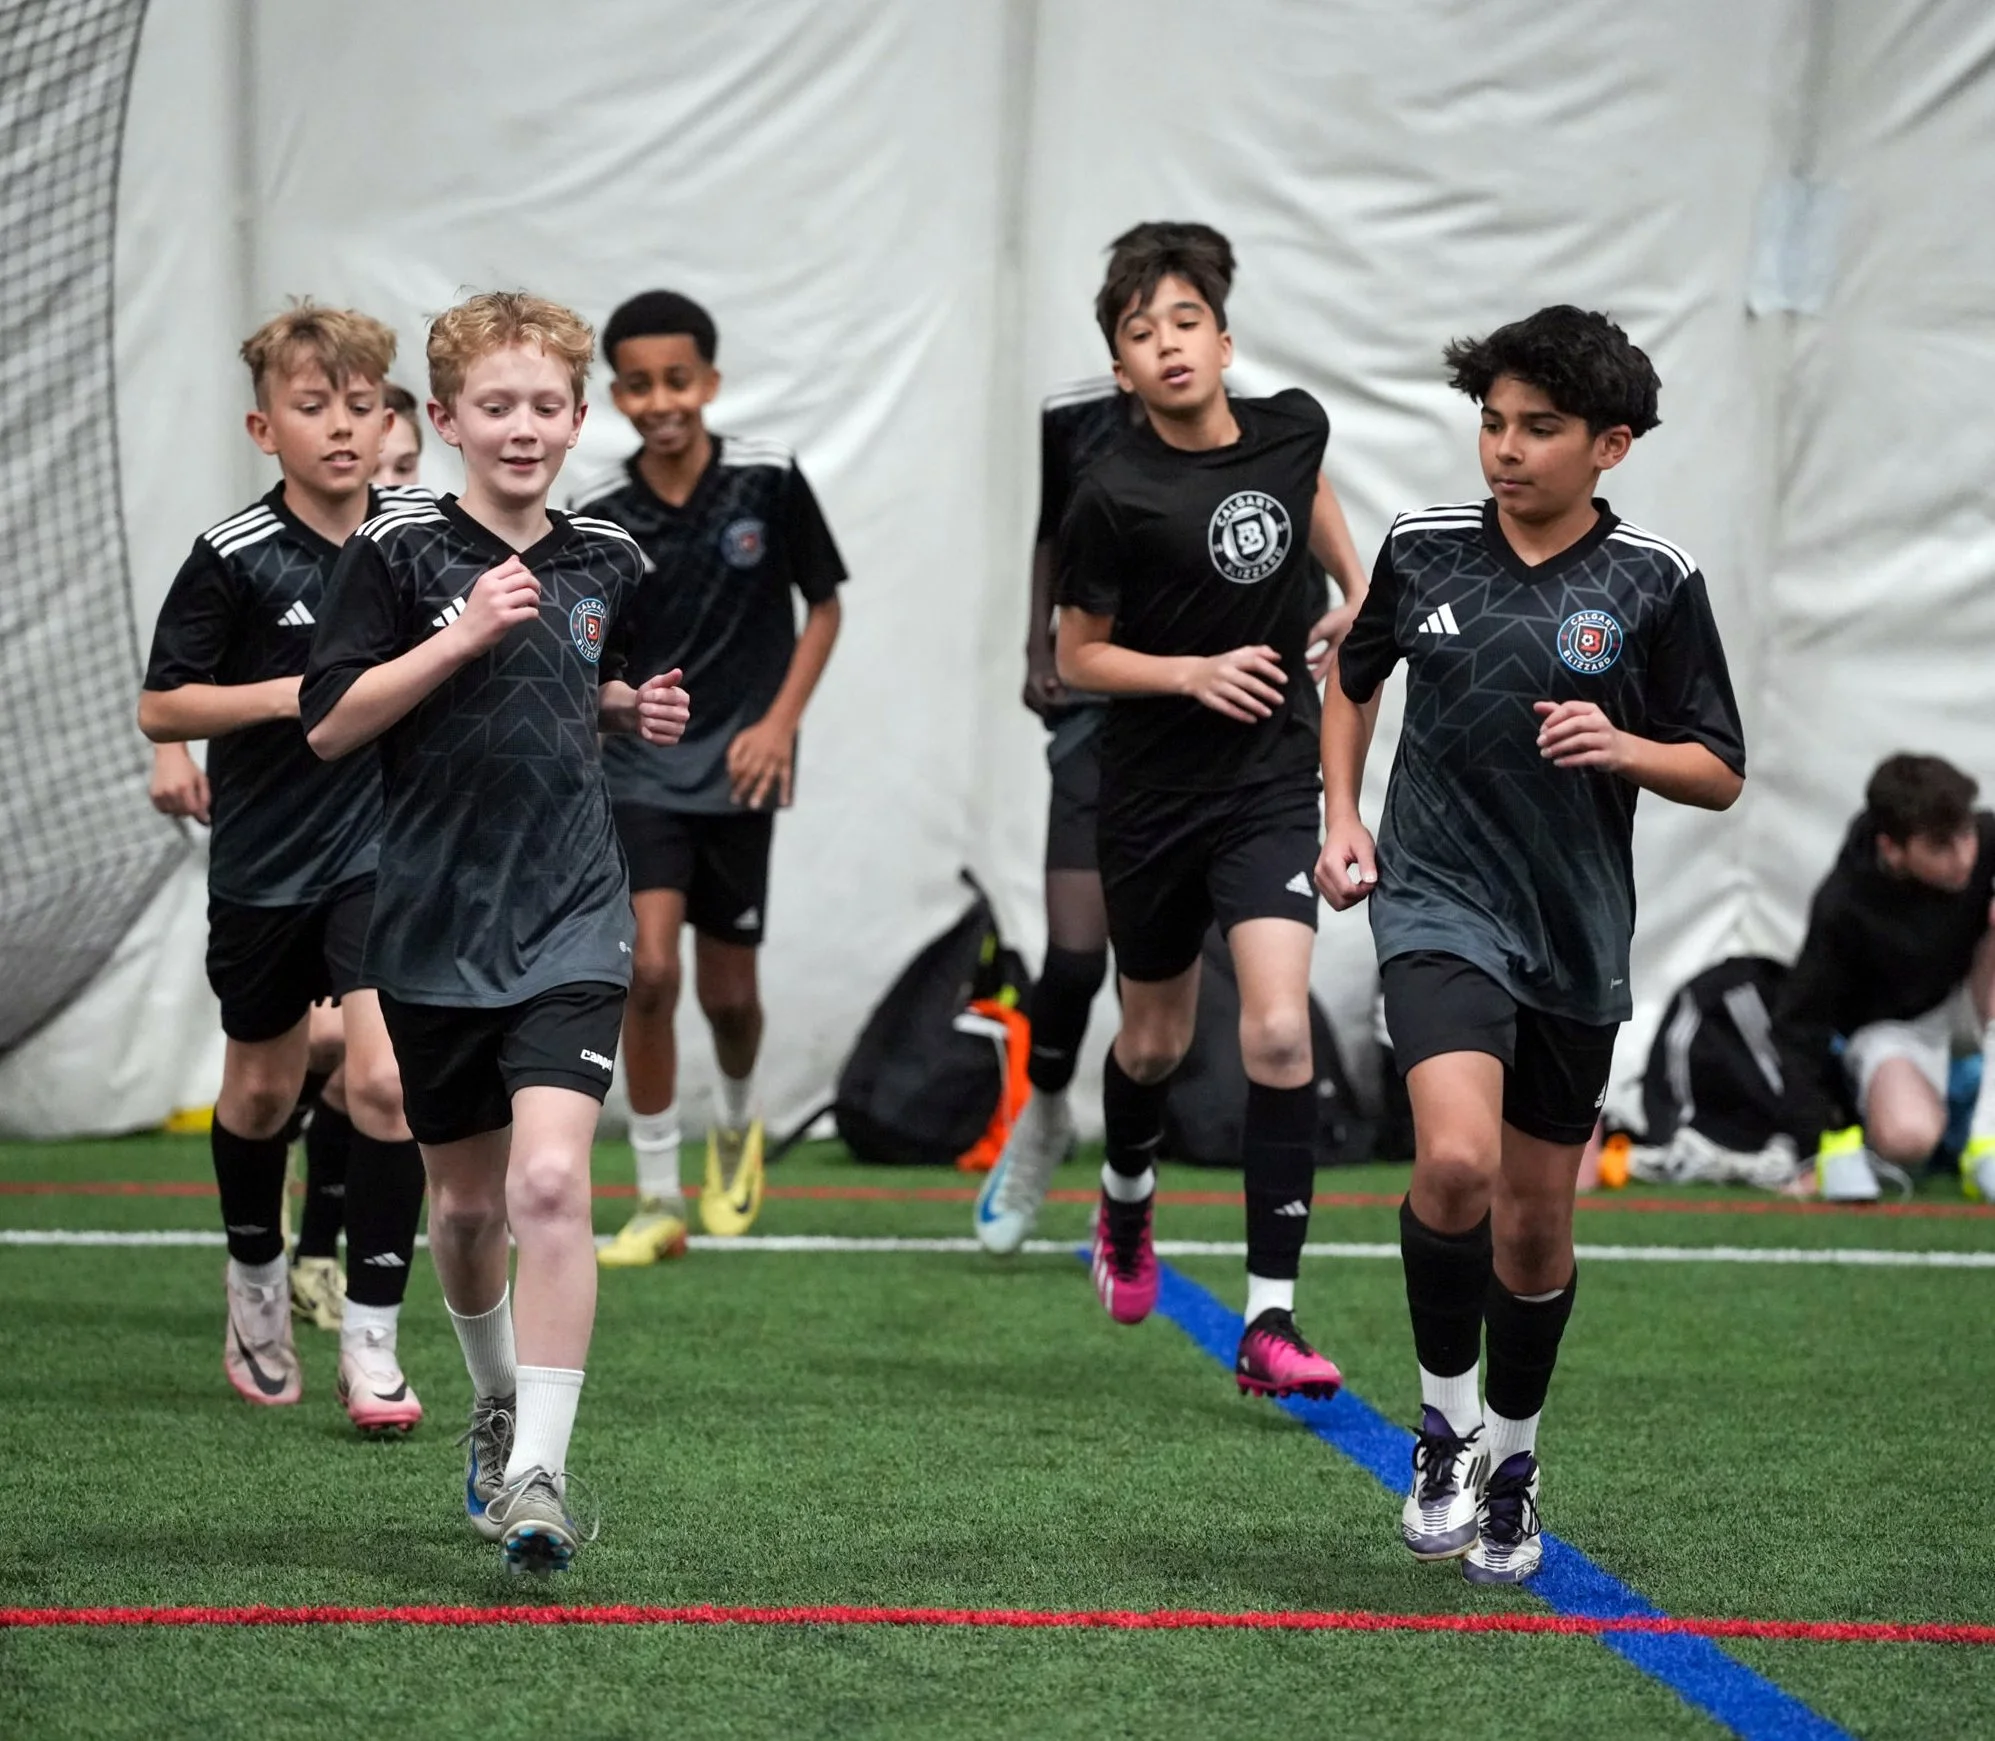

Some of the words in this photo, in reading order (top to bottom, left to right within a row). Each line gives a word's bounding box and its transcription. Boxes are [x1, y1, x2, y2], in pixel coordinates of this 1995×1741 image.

[1216, 495, 1275, 527] CALGARY
[1570, 613, 1617, 631] CALGARY
[1563, 649, 1611, 671] BLIZZARD
